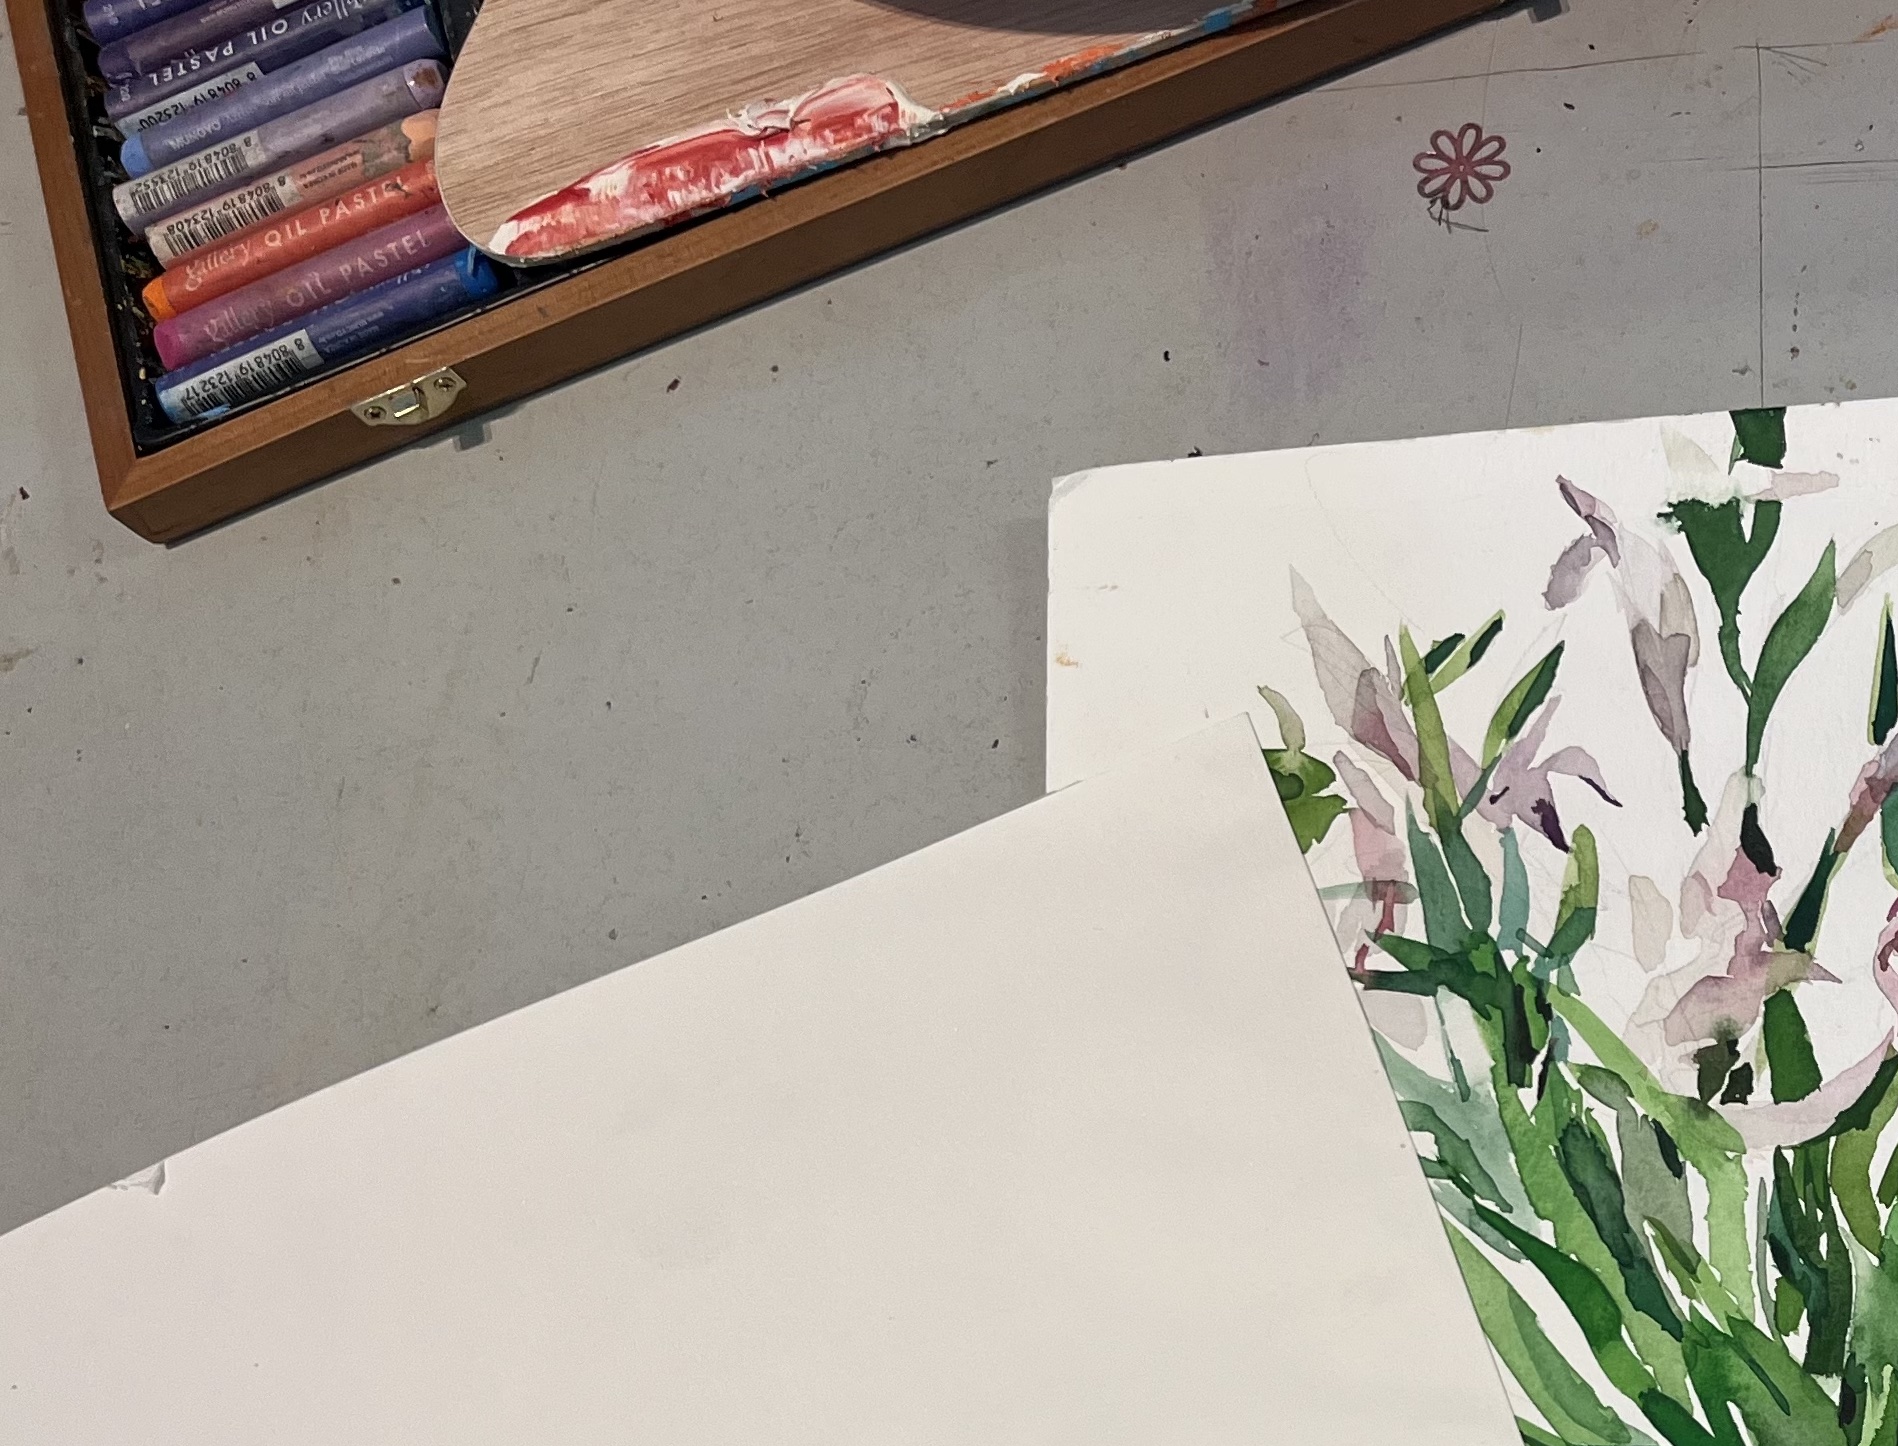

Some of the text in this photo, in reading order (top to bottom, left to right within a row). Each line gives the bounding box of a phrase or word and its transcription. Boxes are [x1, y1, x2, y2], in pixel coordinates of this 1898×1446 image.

[247, 19, 288, 45] OIL
[149, 41, 234, 86] PASTEL
[265, 218, 307, 248] OIL
[319, 175, 410, 227] PASTEL
[339, 229, 432, 283] PASTEL
[184, 337, 306, 401] 8 804819 123217
